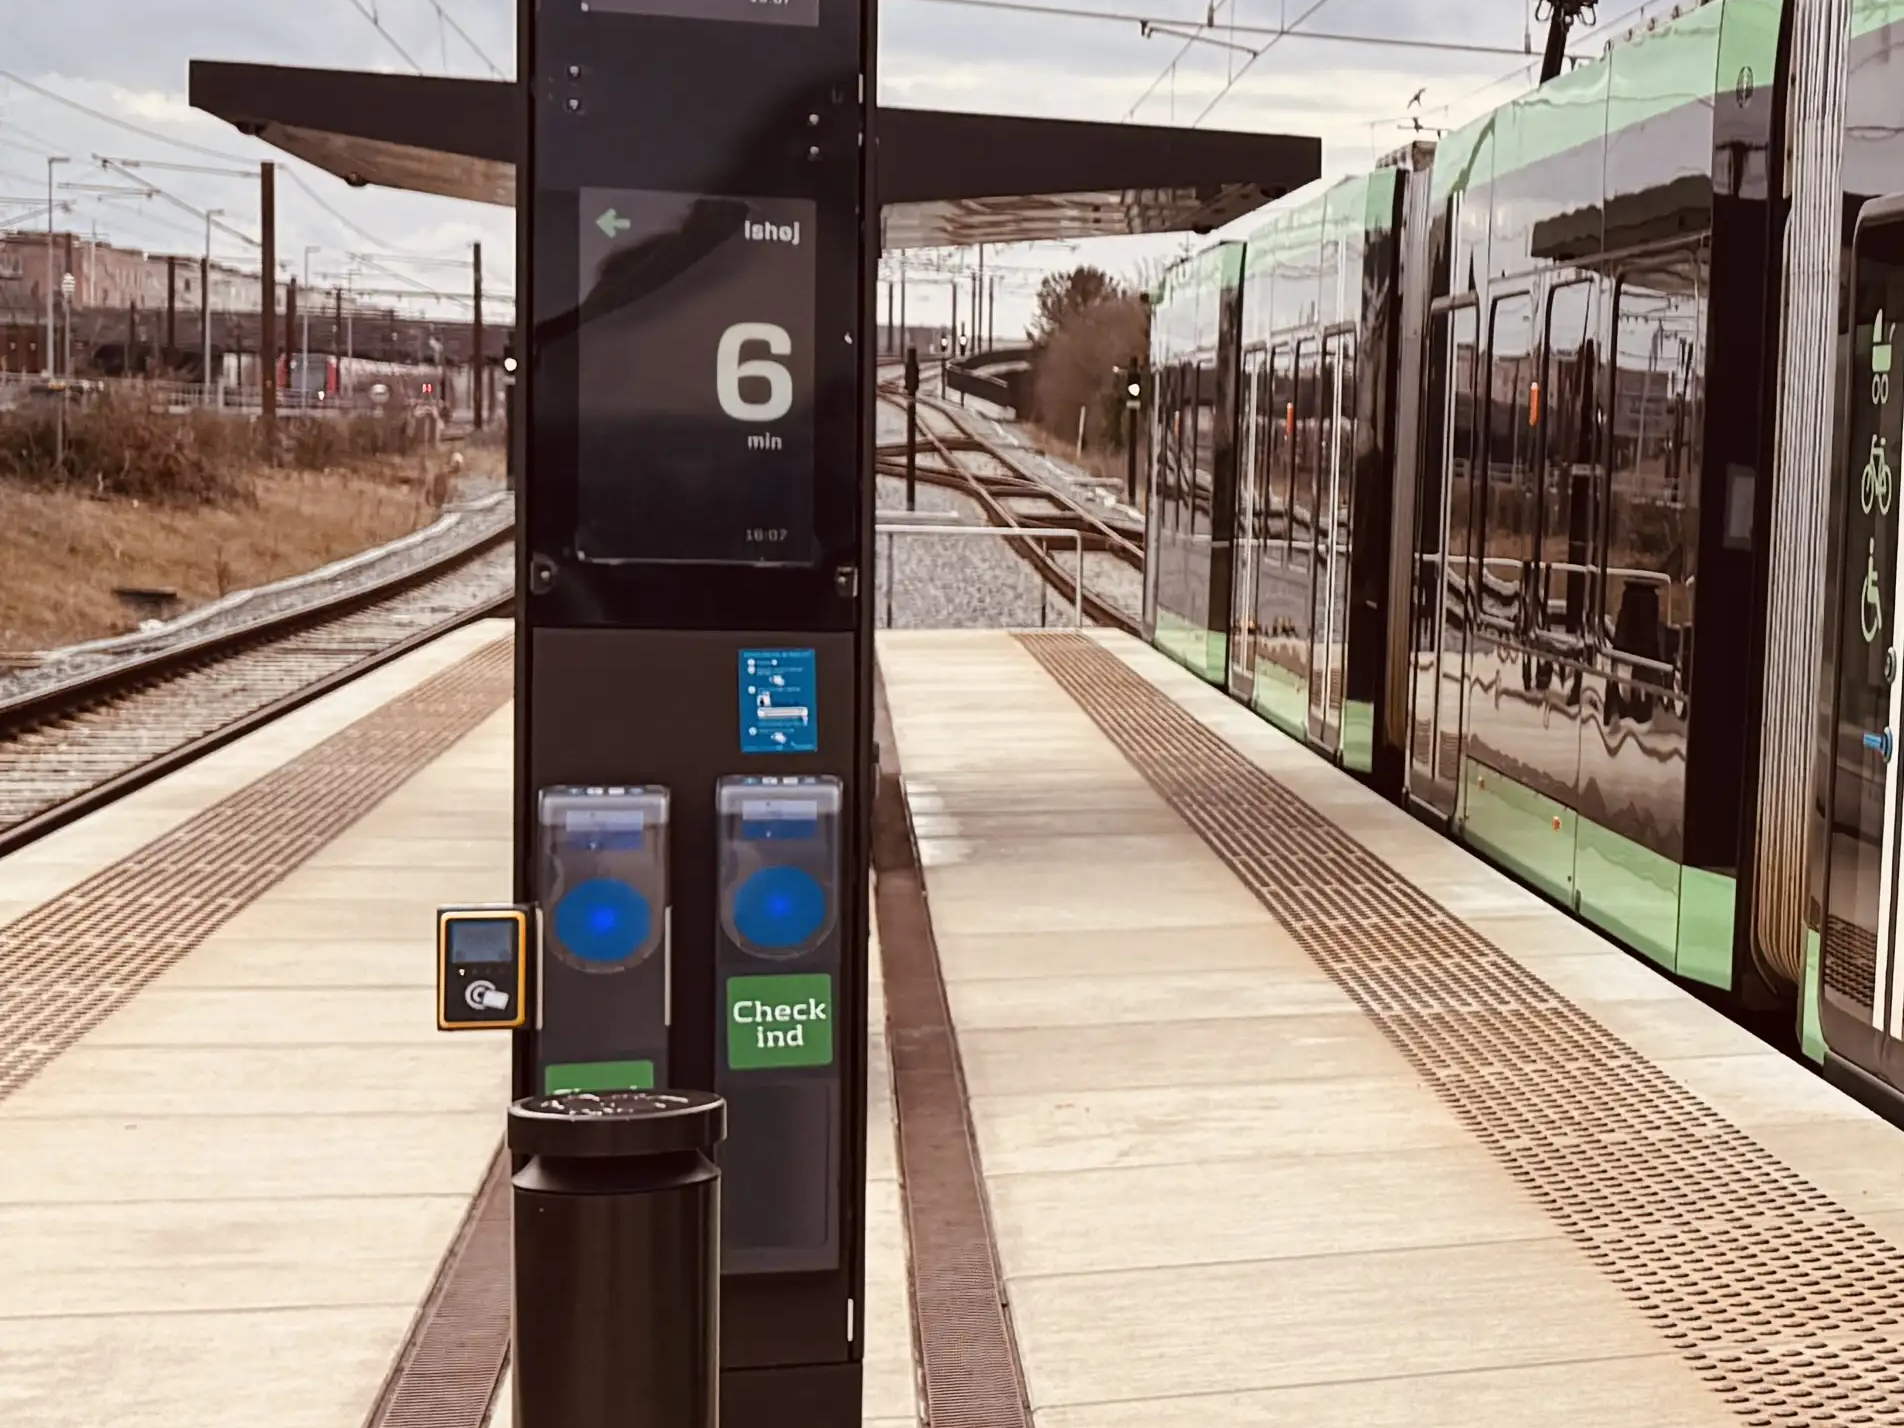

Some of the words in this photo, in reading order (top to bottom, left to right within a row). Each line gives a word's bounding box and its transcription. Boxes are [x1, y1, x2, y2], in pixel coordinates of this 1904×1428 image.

[716, 322, 793, 422] 6
[747, 431, 783, 451] min
[732, 997, 827, 1023] Check
[756, 1023, 805, 1049] ind
